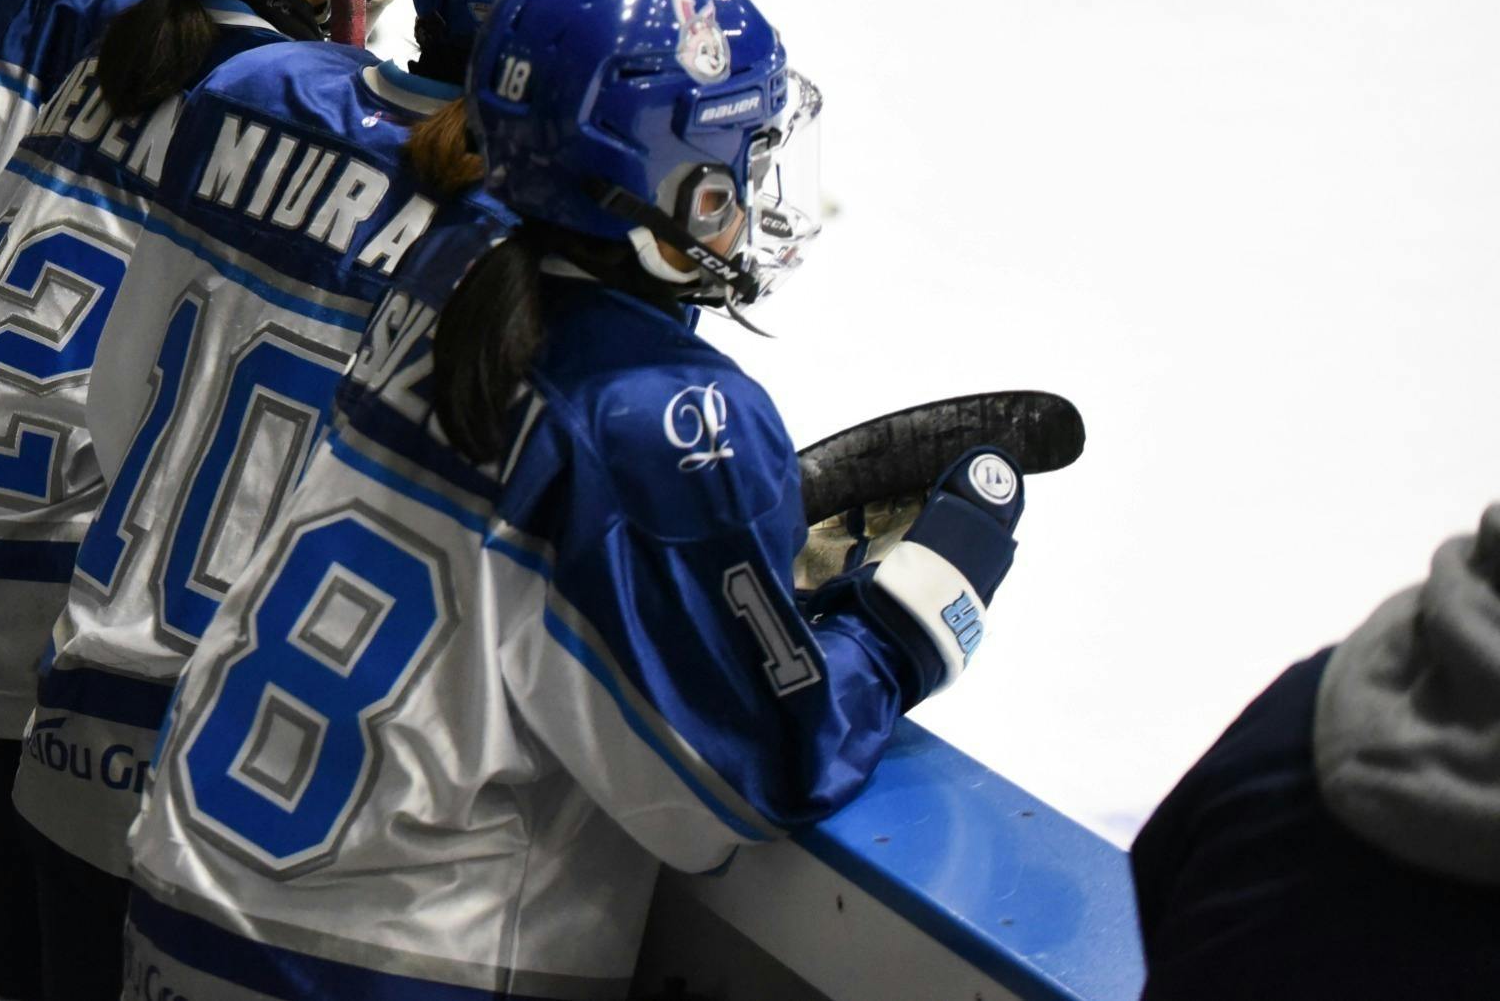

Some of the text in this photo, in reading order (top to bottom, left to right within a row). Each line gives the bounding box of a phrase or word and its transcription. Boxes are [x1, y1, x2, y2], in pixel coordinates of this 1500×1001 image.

[497, 56, 532, 102] 18
[700, 96, 761, 124] BAUER
[197, 112, 438, 276] MIURA
[761, 216, 792, 233] CCM
[686, 245, 740, 281] CCM
[168, 497, 460, 883] 8
